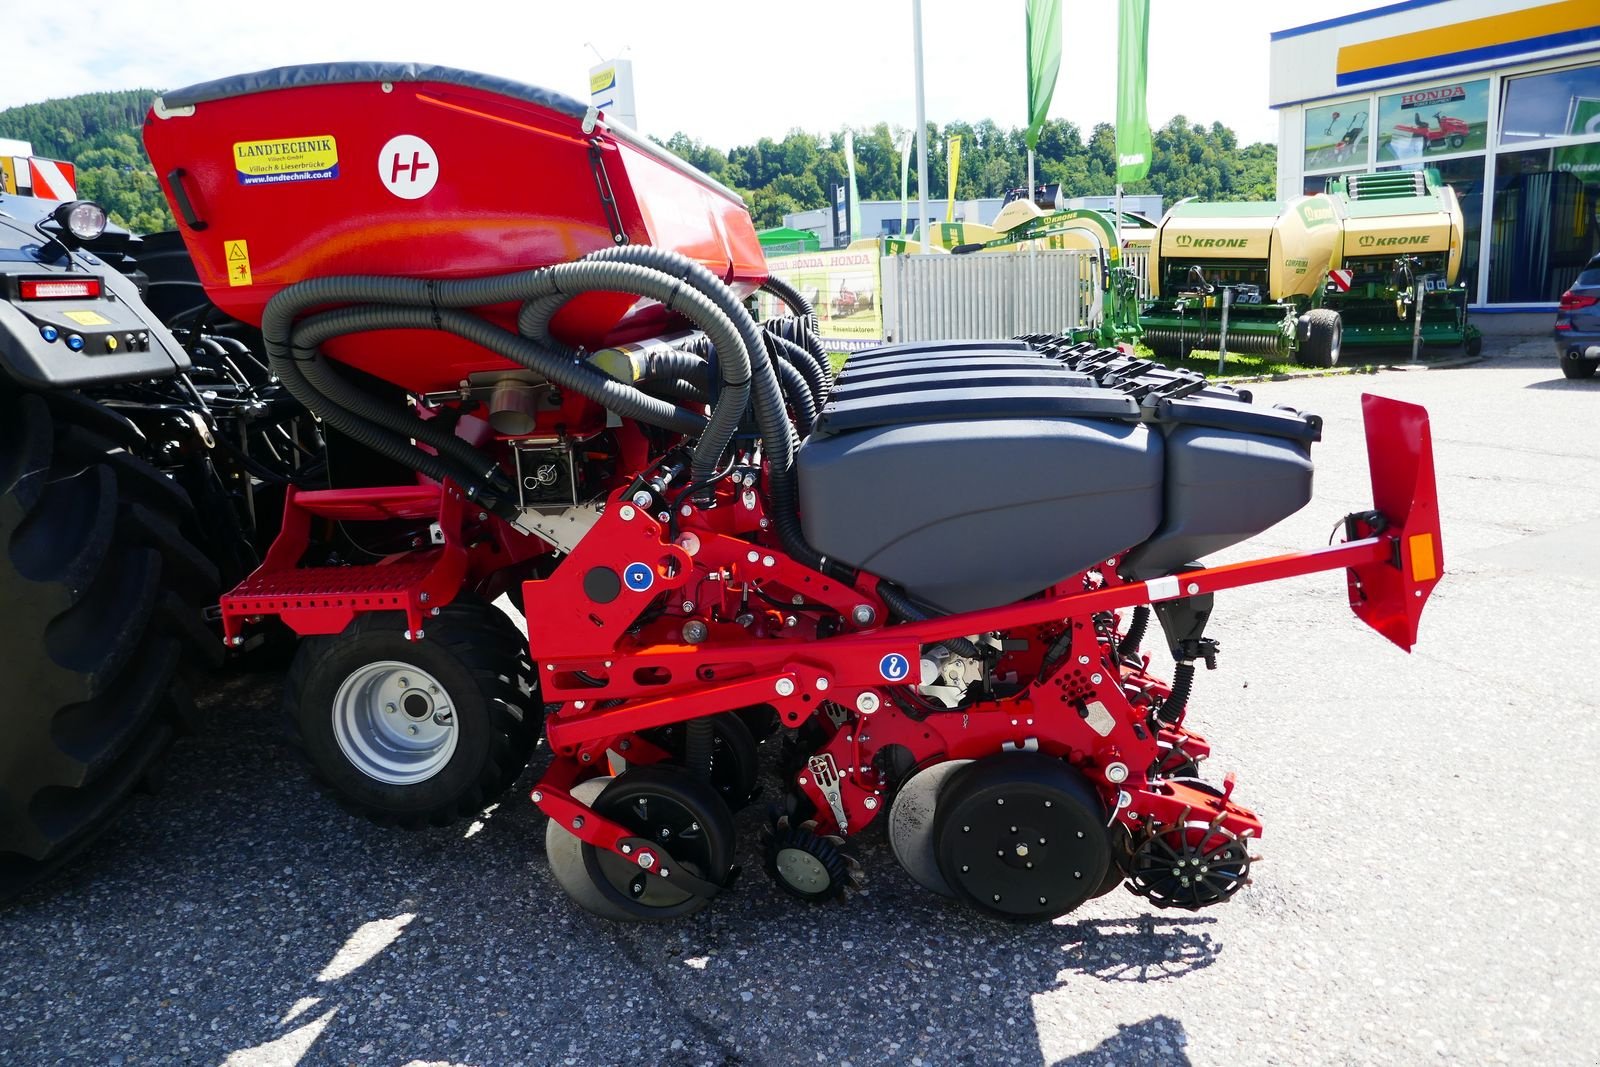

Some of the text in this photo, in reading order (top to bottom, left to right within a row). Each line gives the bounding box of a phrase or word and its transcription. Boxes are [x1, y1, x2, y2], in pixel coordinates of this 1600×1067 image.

[1402, 86, 1465, 104] HONDA
[238, 140, 331, 157] LANDTECHNIK
[249, 163, 273, 172] Villach
[281, 161, 325, 170] Lieserbrücke
[1570, 163, 1600, 172] KRO
[244, 171, 332, 184] www.landtechnik.co.at
[1052, 211, 1078, 223] KRONE
[1192, 238, 1249, 248] KRONE
[1376, 235, 1430, 246] KRONE
[793, 258, 824, 268] HONDA
[830, 254, 870, 266] HONDA
